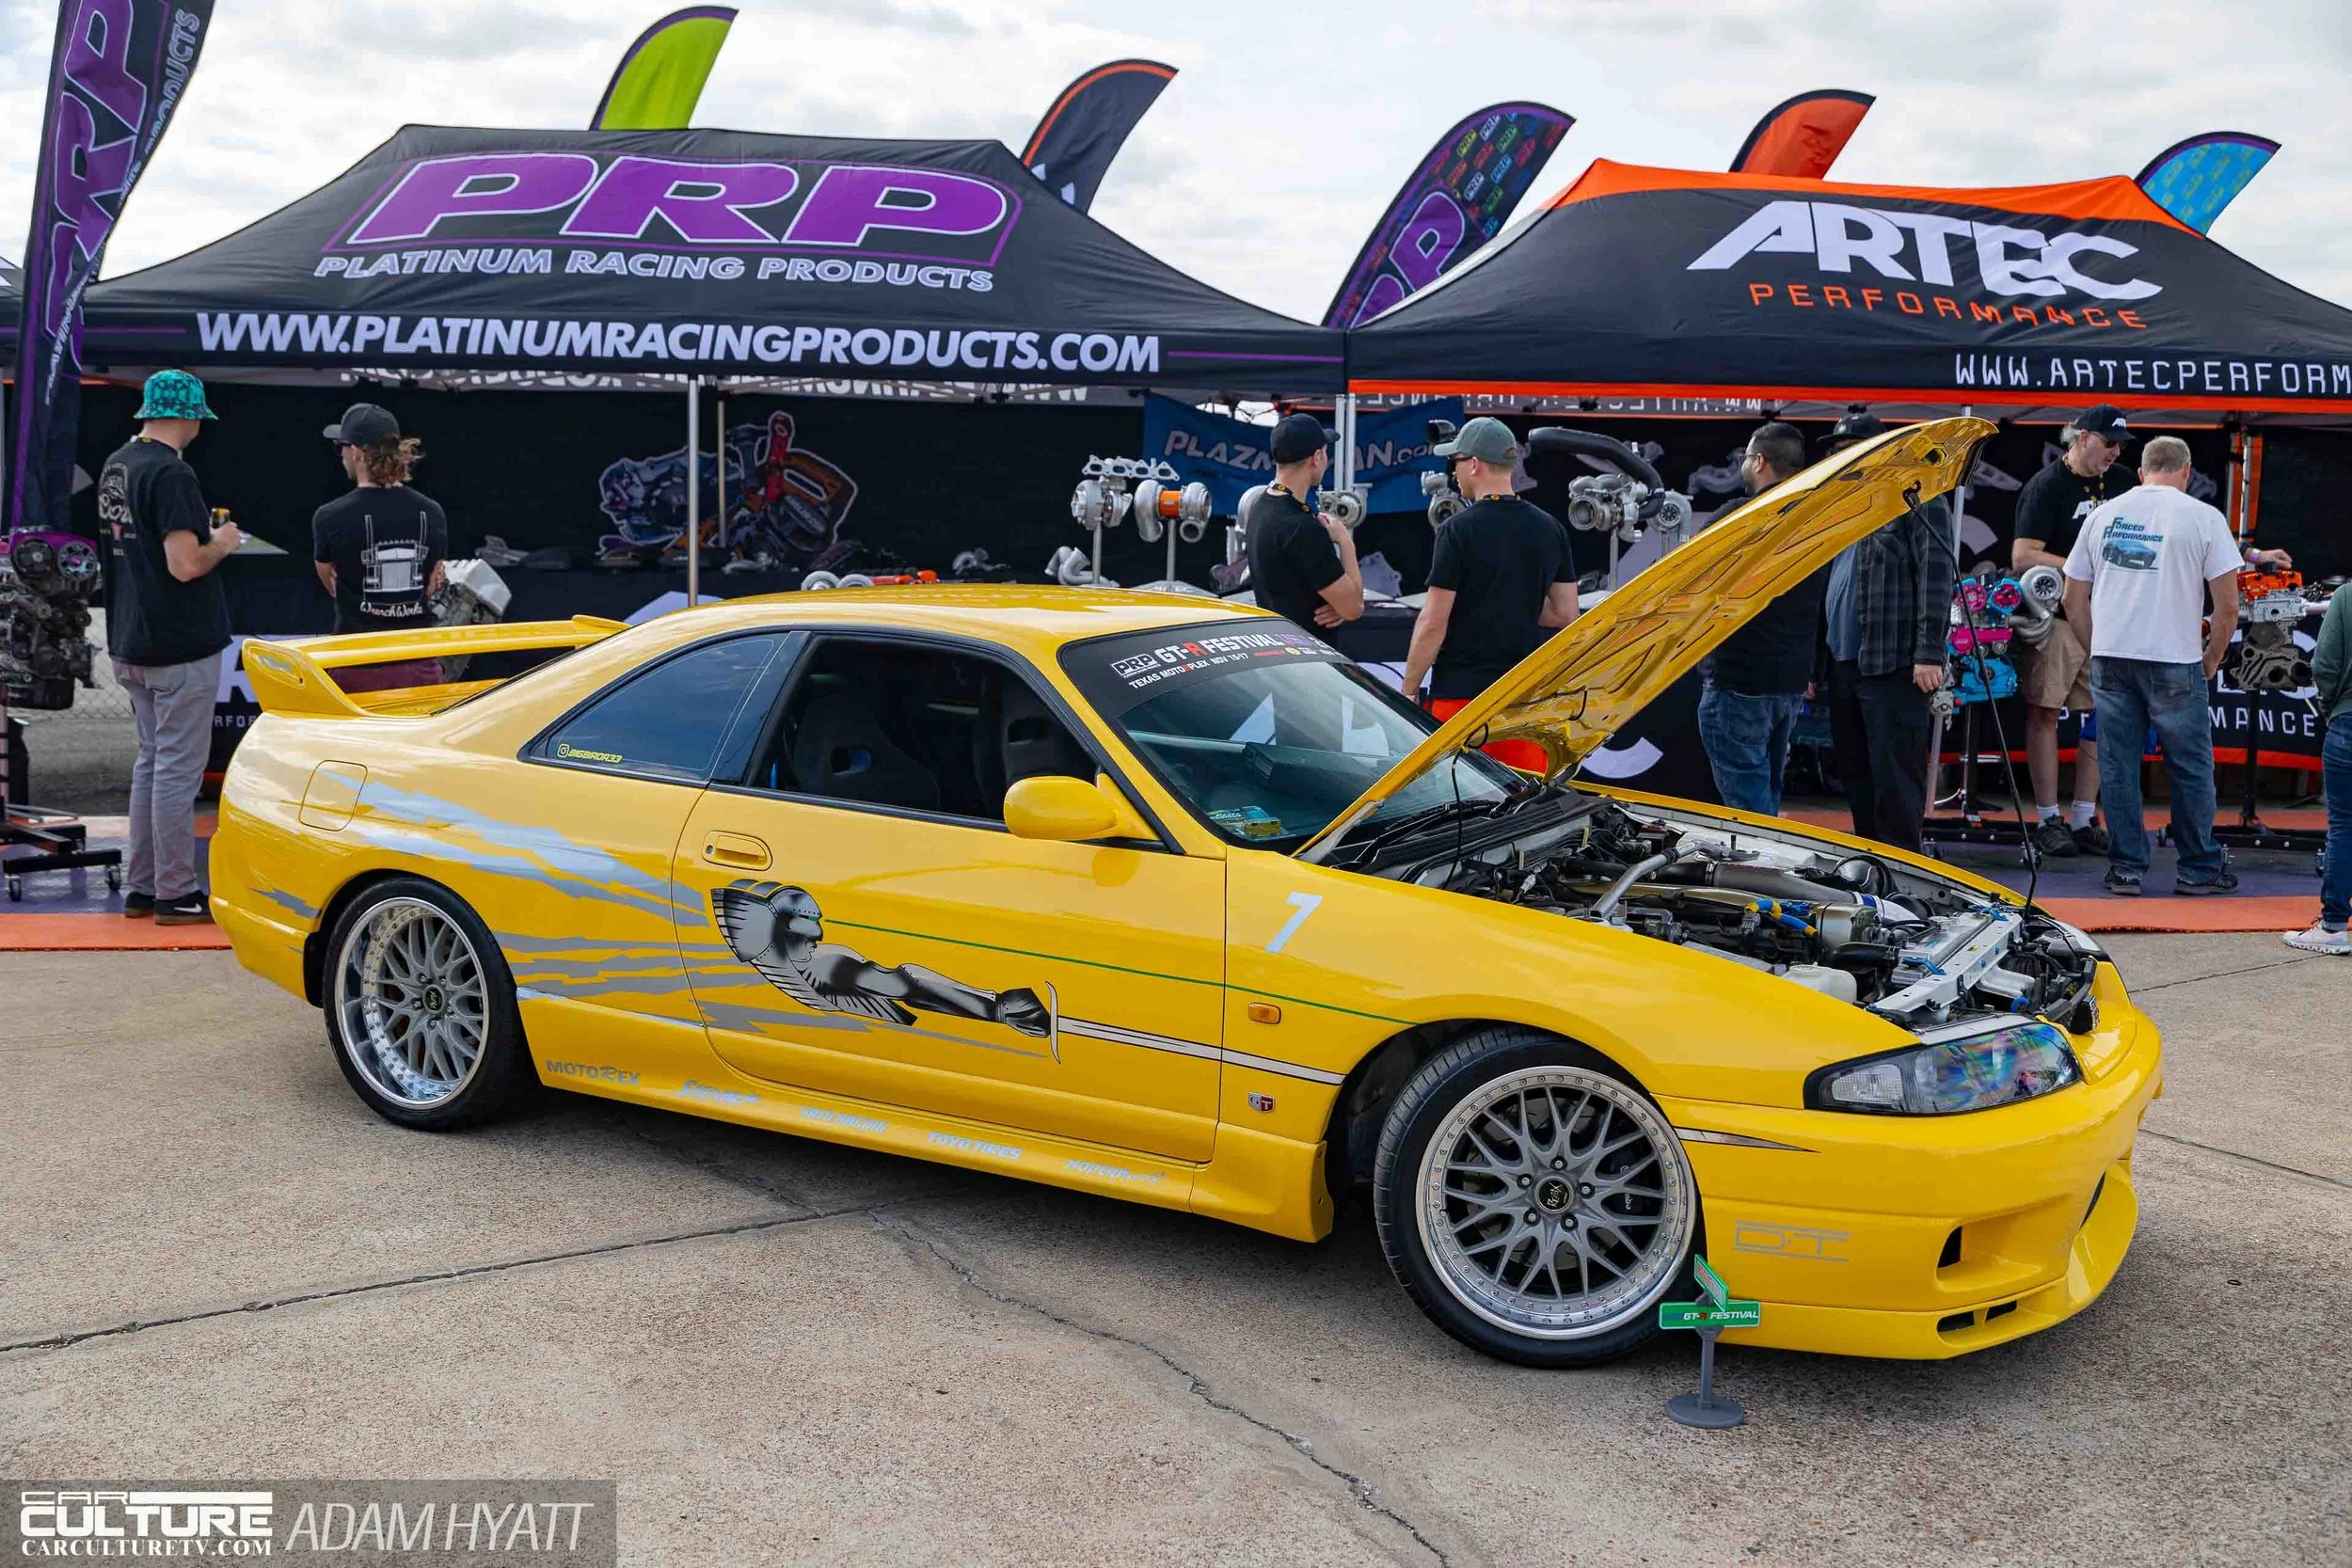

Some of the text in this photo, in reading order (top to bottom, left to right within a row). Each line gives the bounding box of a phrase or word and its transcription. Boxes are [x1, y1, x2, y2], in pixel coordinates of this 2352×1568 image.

[345, 152, 1008, 247] PRP
[1687, 199, 2163, 300] ARTEC
[313, 248, 993, 293] PLATINUM RACING PRODUCTS
[1750, 283, 2147, 329] PERFORMANCE
[197, 311, 1159, 373] WWW.PLATINUMRACINGPRODUCTS.COM
[1154, 641, 1209, 664] GT-R
[1202, 633, 1286, 654] FESTIVAL
[1129, 673, 1163, 689] TEXAS
[1162, 660, 1211, 680] MOTORPLEX
[1211, 656, 1229, 666] NOV
[546, 1059, 641, 1087] MOTOREX
[1248, 1091, 1276, 1114] GT
[926, 1130, 1024, 1160] TOYO TIRES
[1683, 1308, 1759, 1322] GT-R FESTIVAL
